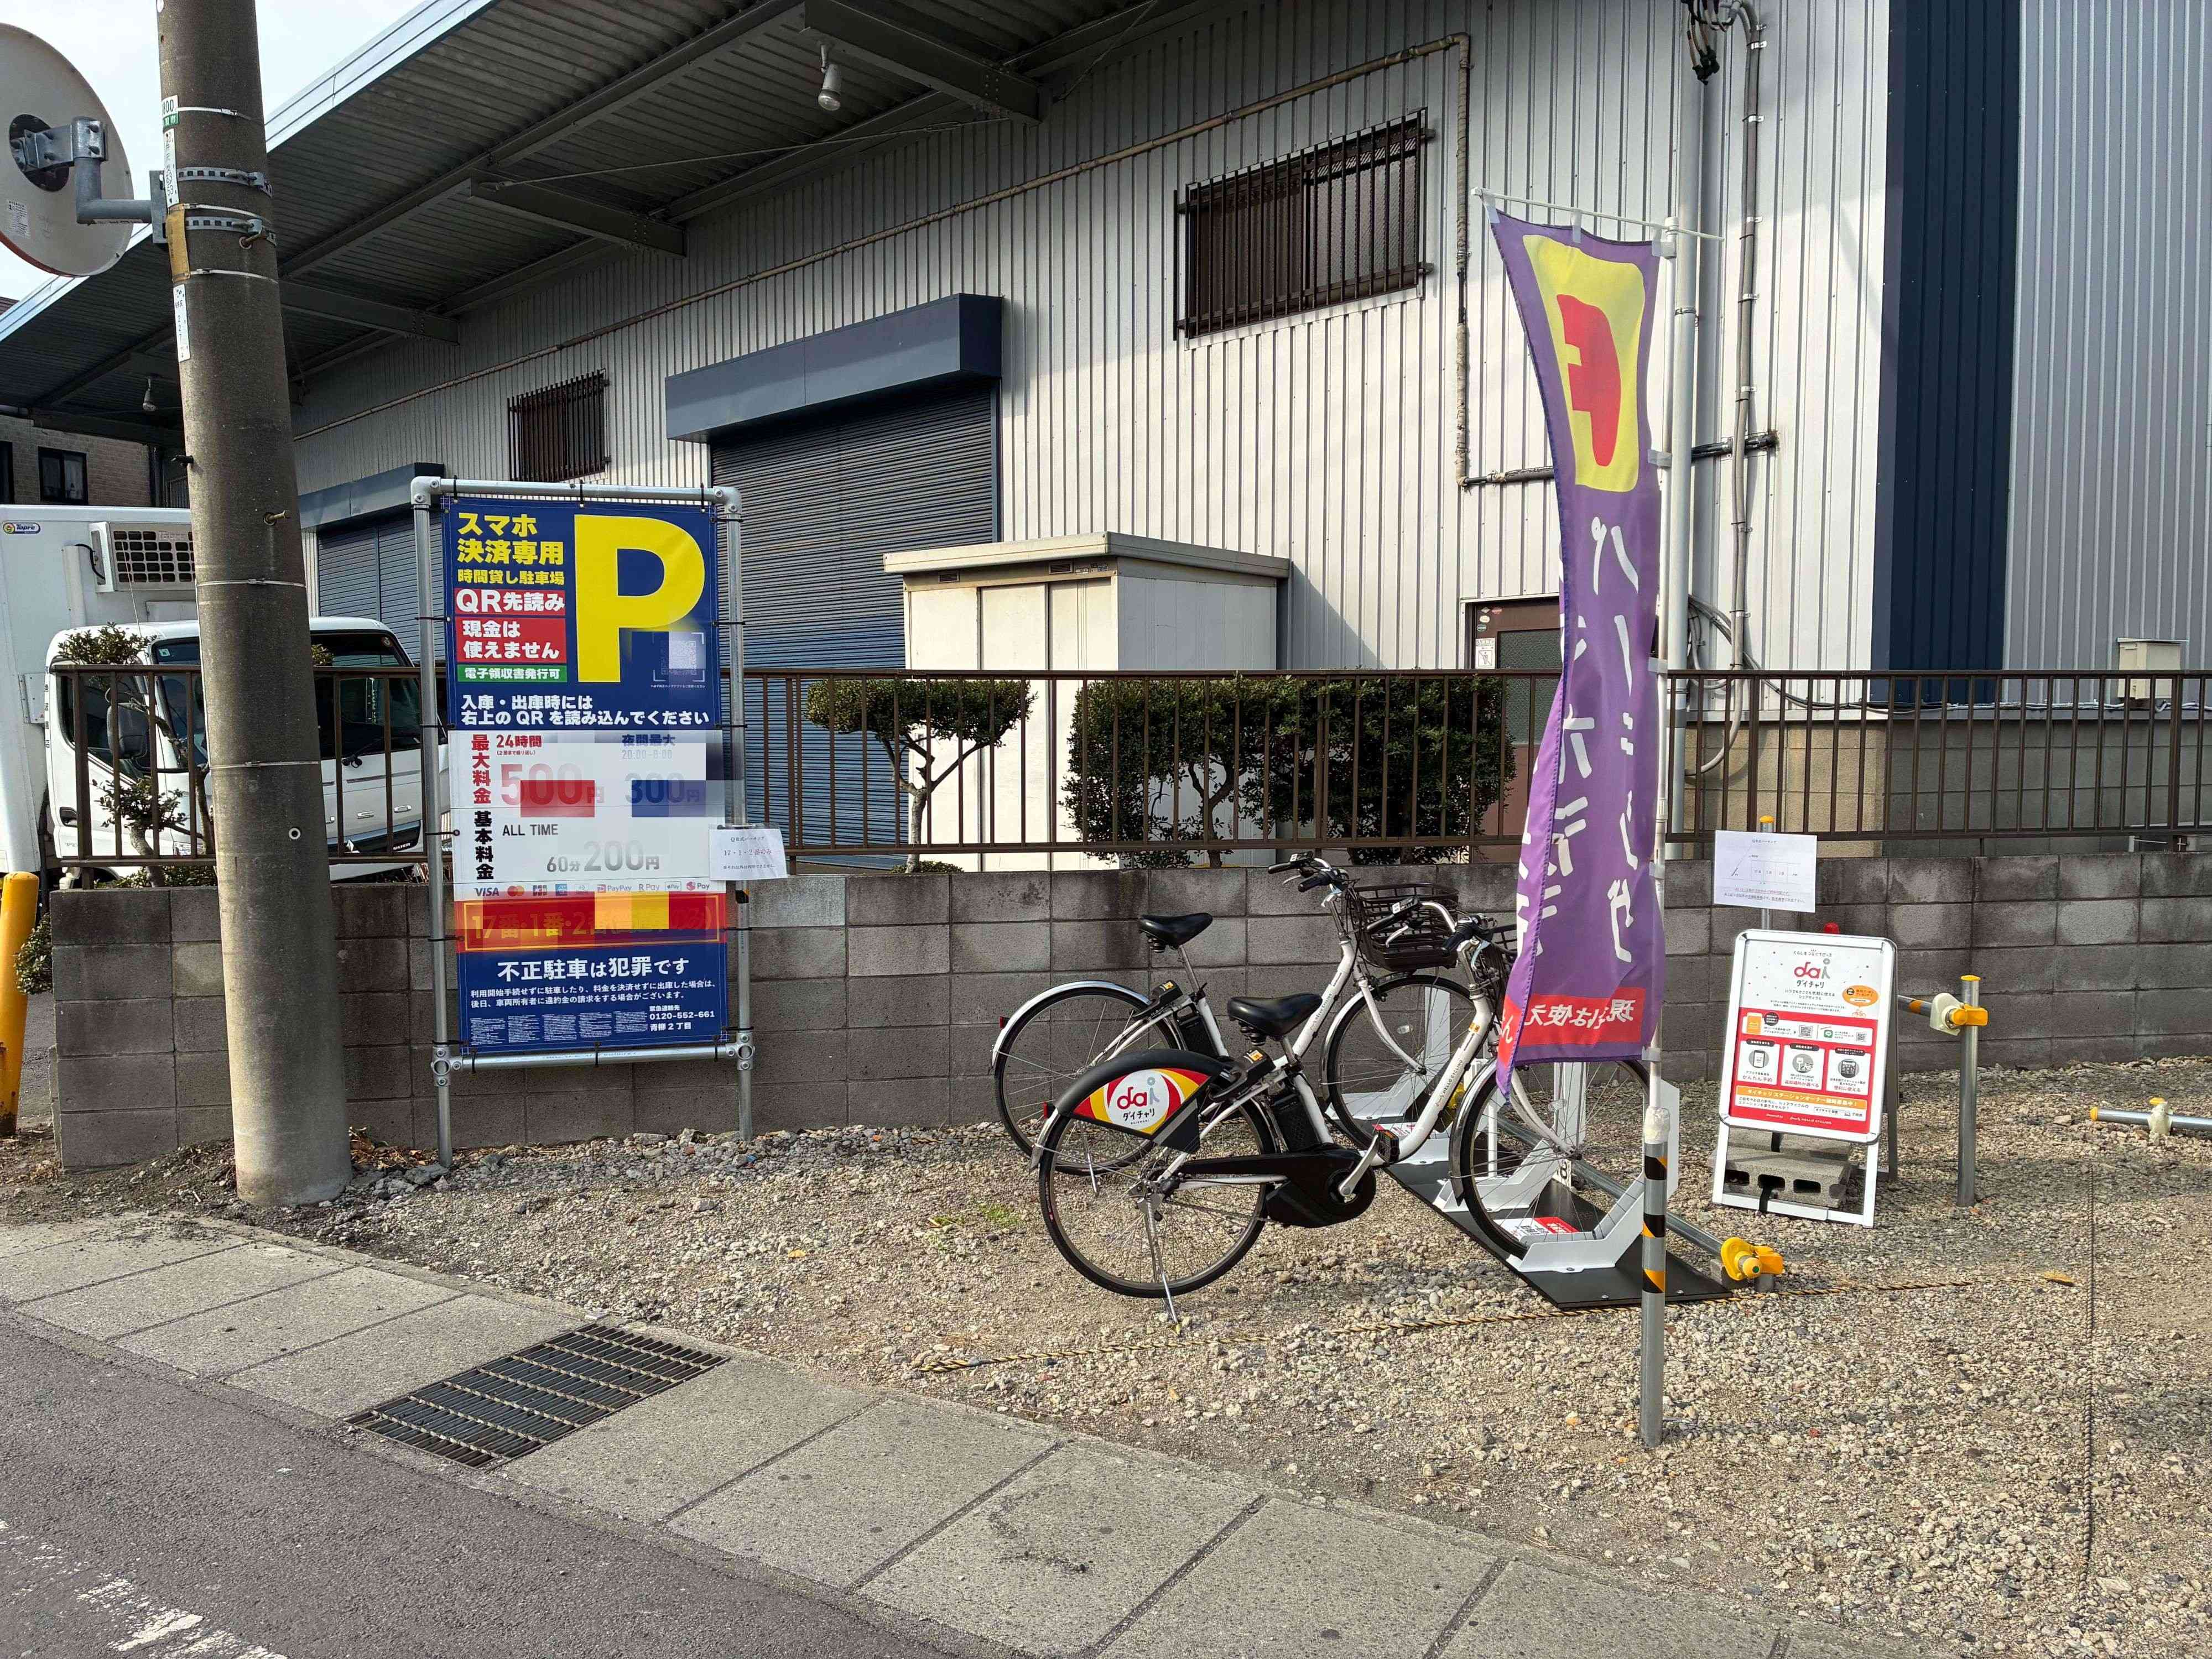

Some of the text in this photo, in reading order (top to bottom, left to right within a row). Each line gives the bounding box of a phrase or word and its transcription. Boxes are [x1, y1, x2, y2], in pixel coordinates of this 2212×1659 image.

[457, 513, 537, 536] スマホ
[457, 538, 565, 566] 決済専用
[457, 568, 565, 586] 時間貸し駐車場
[456, 588, 565, 613] QR先読み
[574, 514, 705, 682] P
[463, 620, 520, 638] 現金は
[464, 640, 559, 660] 使えません
[464, 667, 560, 680] 電子領収書発行可
[461, 695, 593, 710] 入庫・出庫時には
[461, 711, 510, 726] 右上の
[549, 709, 710, 726] を読み込んでください
[496, 734, 543, 749] 24時間
[621, 734, 676, 747] 夜間最大
[471, 734, 492, 805] 最大料金
[502, 823, 559, 837] ALL TIME
[473, 811, 494, 879] 基本料金
[474, 888, 499, 896] VISA
[497, 957, 690, 982] 不正駐車は犯罪です
[1797, 980, 1824, 989] ダイチャリ
[649, 1010, 715, 1020] 0120-552-661
[1443, 1059, 1463, 1094] HELLO CYCLING
[1117, 1077, 1160, 1110] dai
[1123, 1108, 1155, 1121] ダイチャリ
